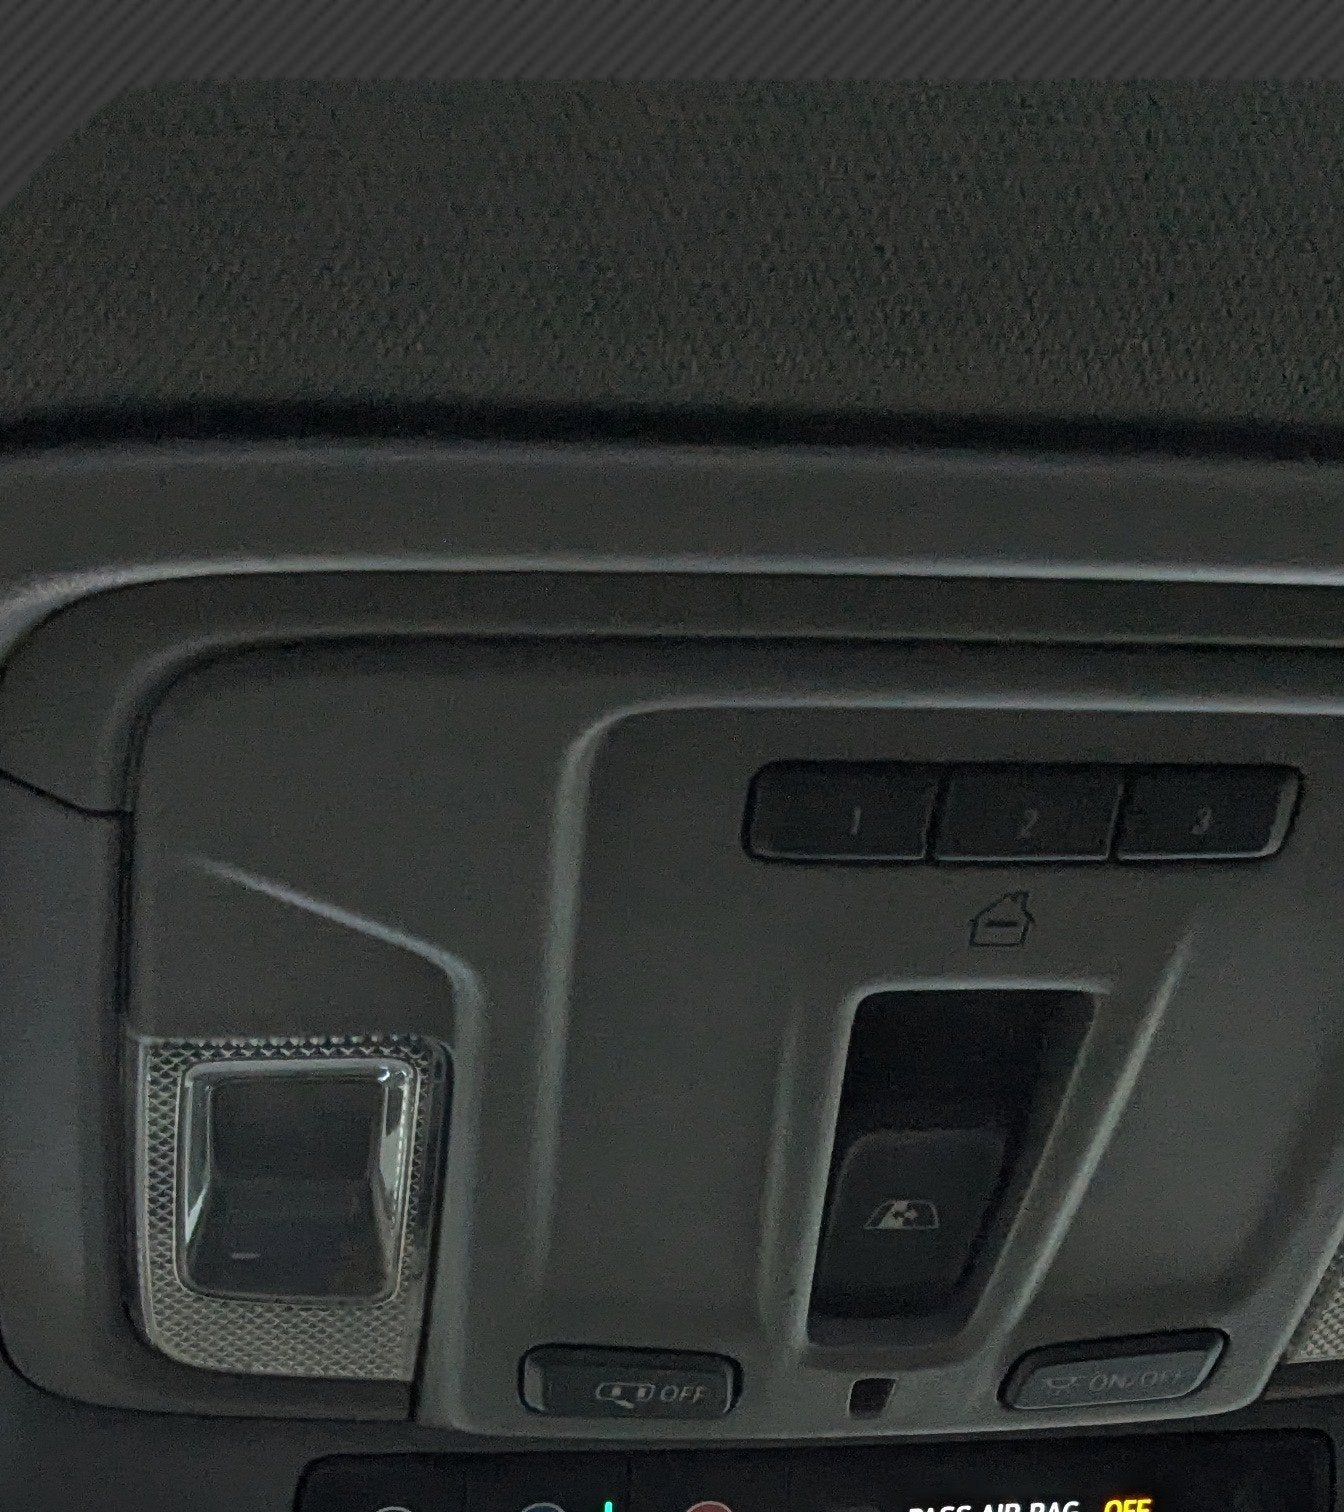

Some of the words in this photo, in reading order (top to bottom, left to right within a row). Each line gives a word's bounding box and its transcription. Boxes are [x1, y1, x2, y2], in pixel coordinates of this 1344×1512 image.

[849, 806, 862, 836] 1
[1017, 807, 1040, 838] 2
[1190, 806, 1213, 835] 3
[660, 1385, 706, 1402] OFF
